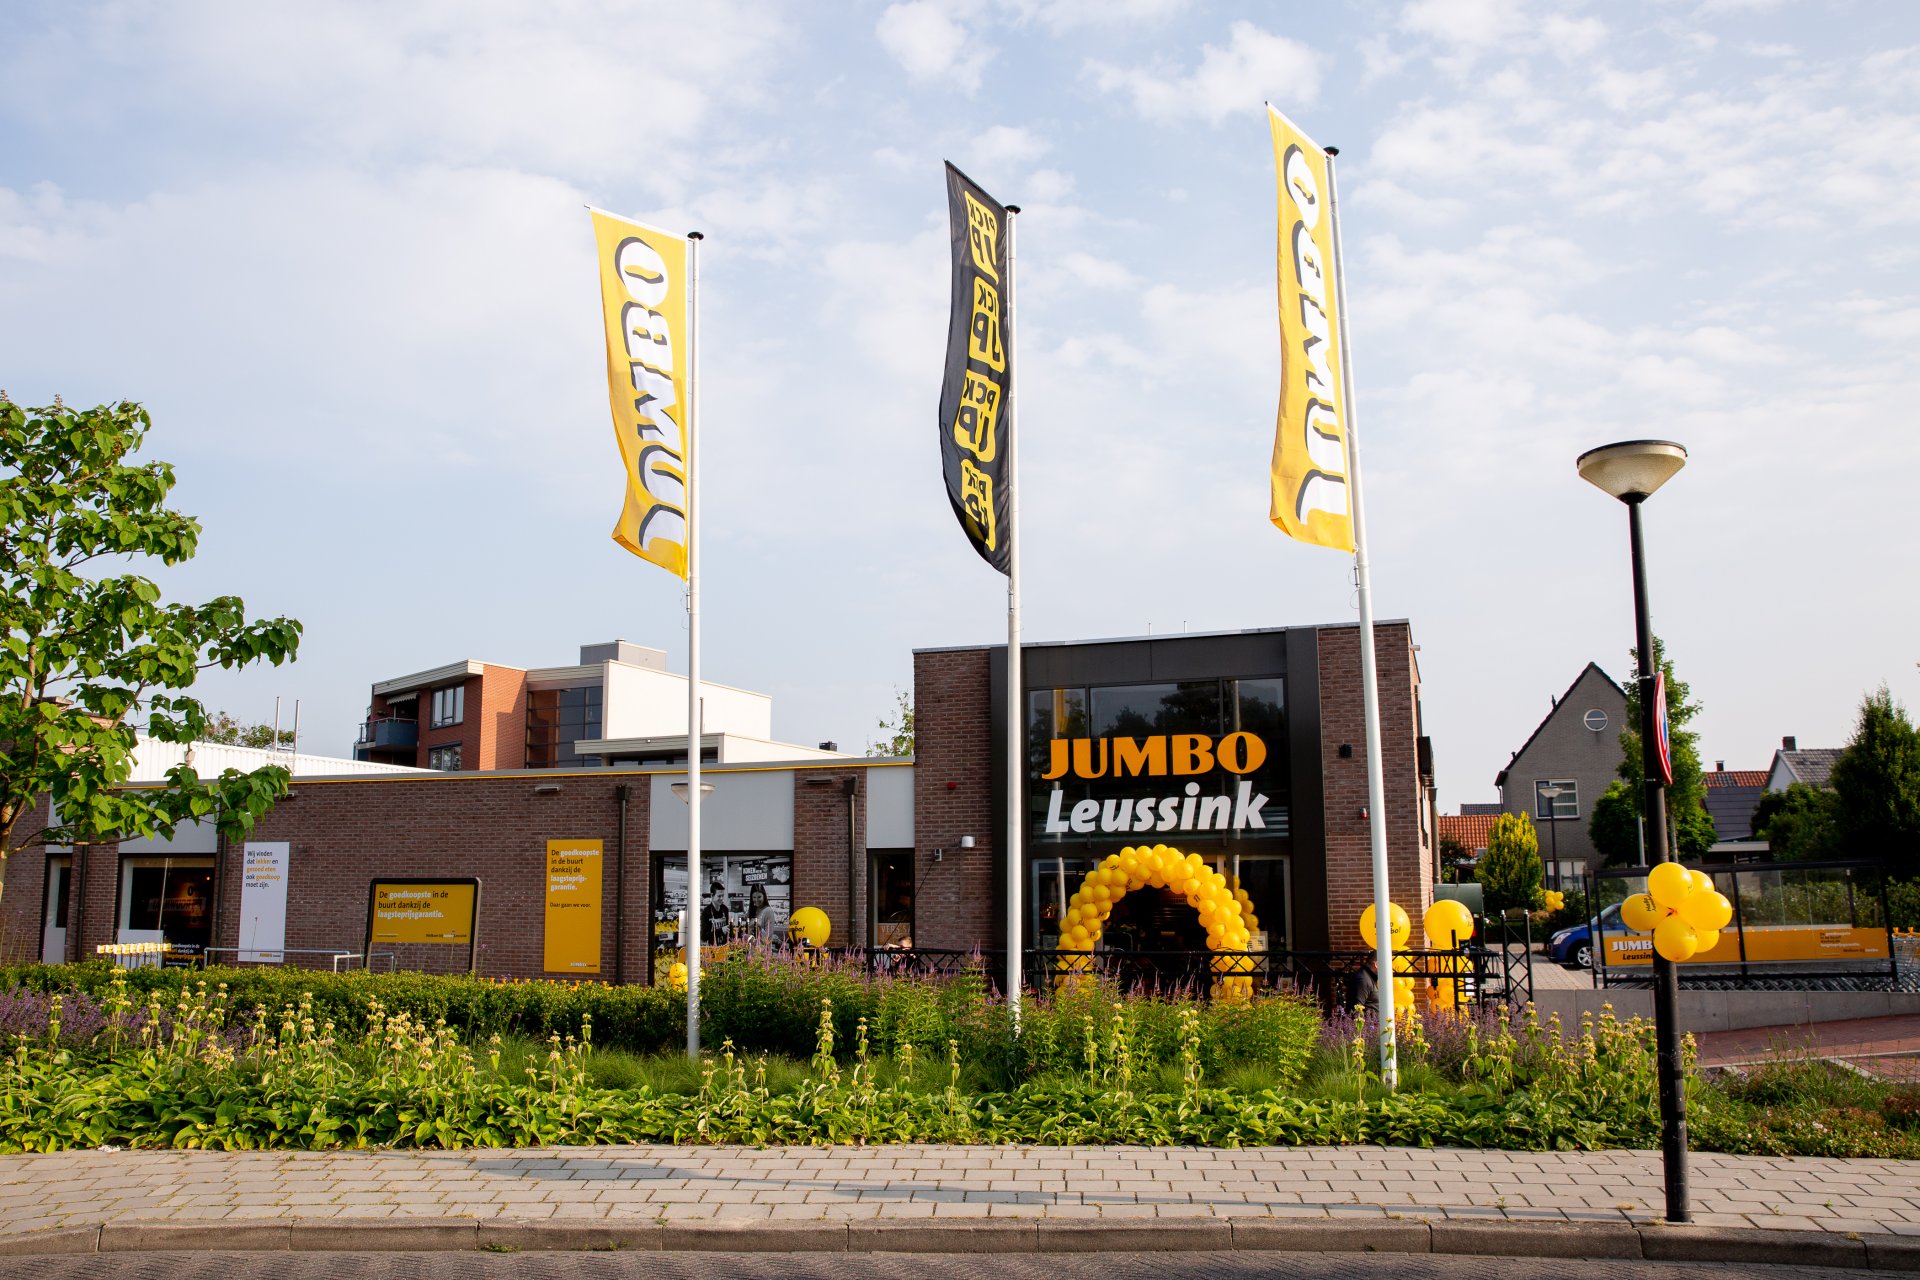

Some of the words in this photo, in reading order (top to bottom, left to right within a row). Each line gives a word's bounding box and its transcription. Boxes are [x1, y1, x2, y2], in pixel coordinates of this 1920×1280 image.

[1042, 732, 1267, 780] JUMBO
[1046, 781, 1269, 833] Leussink
[560, 849, 599, 857] goedkoopste
[551, 867, 572, 875] dankzij
[550, 883, 578, 892] garantie.
[389, 890, 431, 900] goedkoopste
[440, 890, 448, 898] de
[398, 901, 421, 910] dankzij
[377, 910, 444, 920] laagsteprijsgarantie.
[1612, 940, 1653, 952] JUMB
